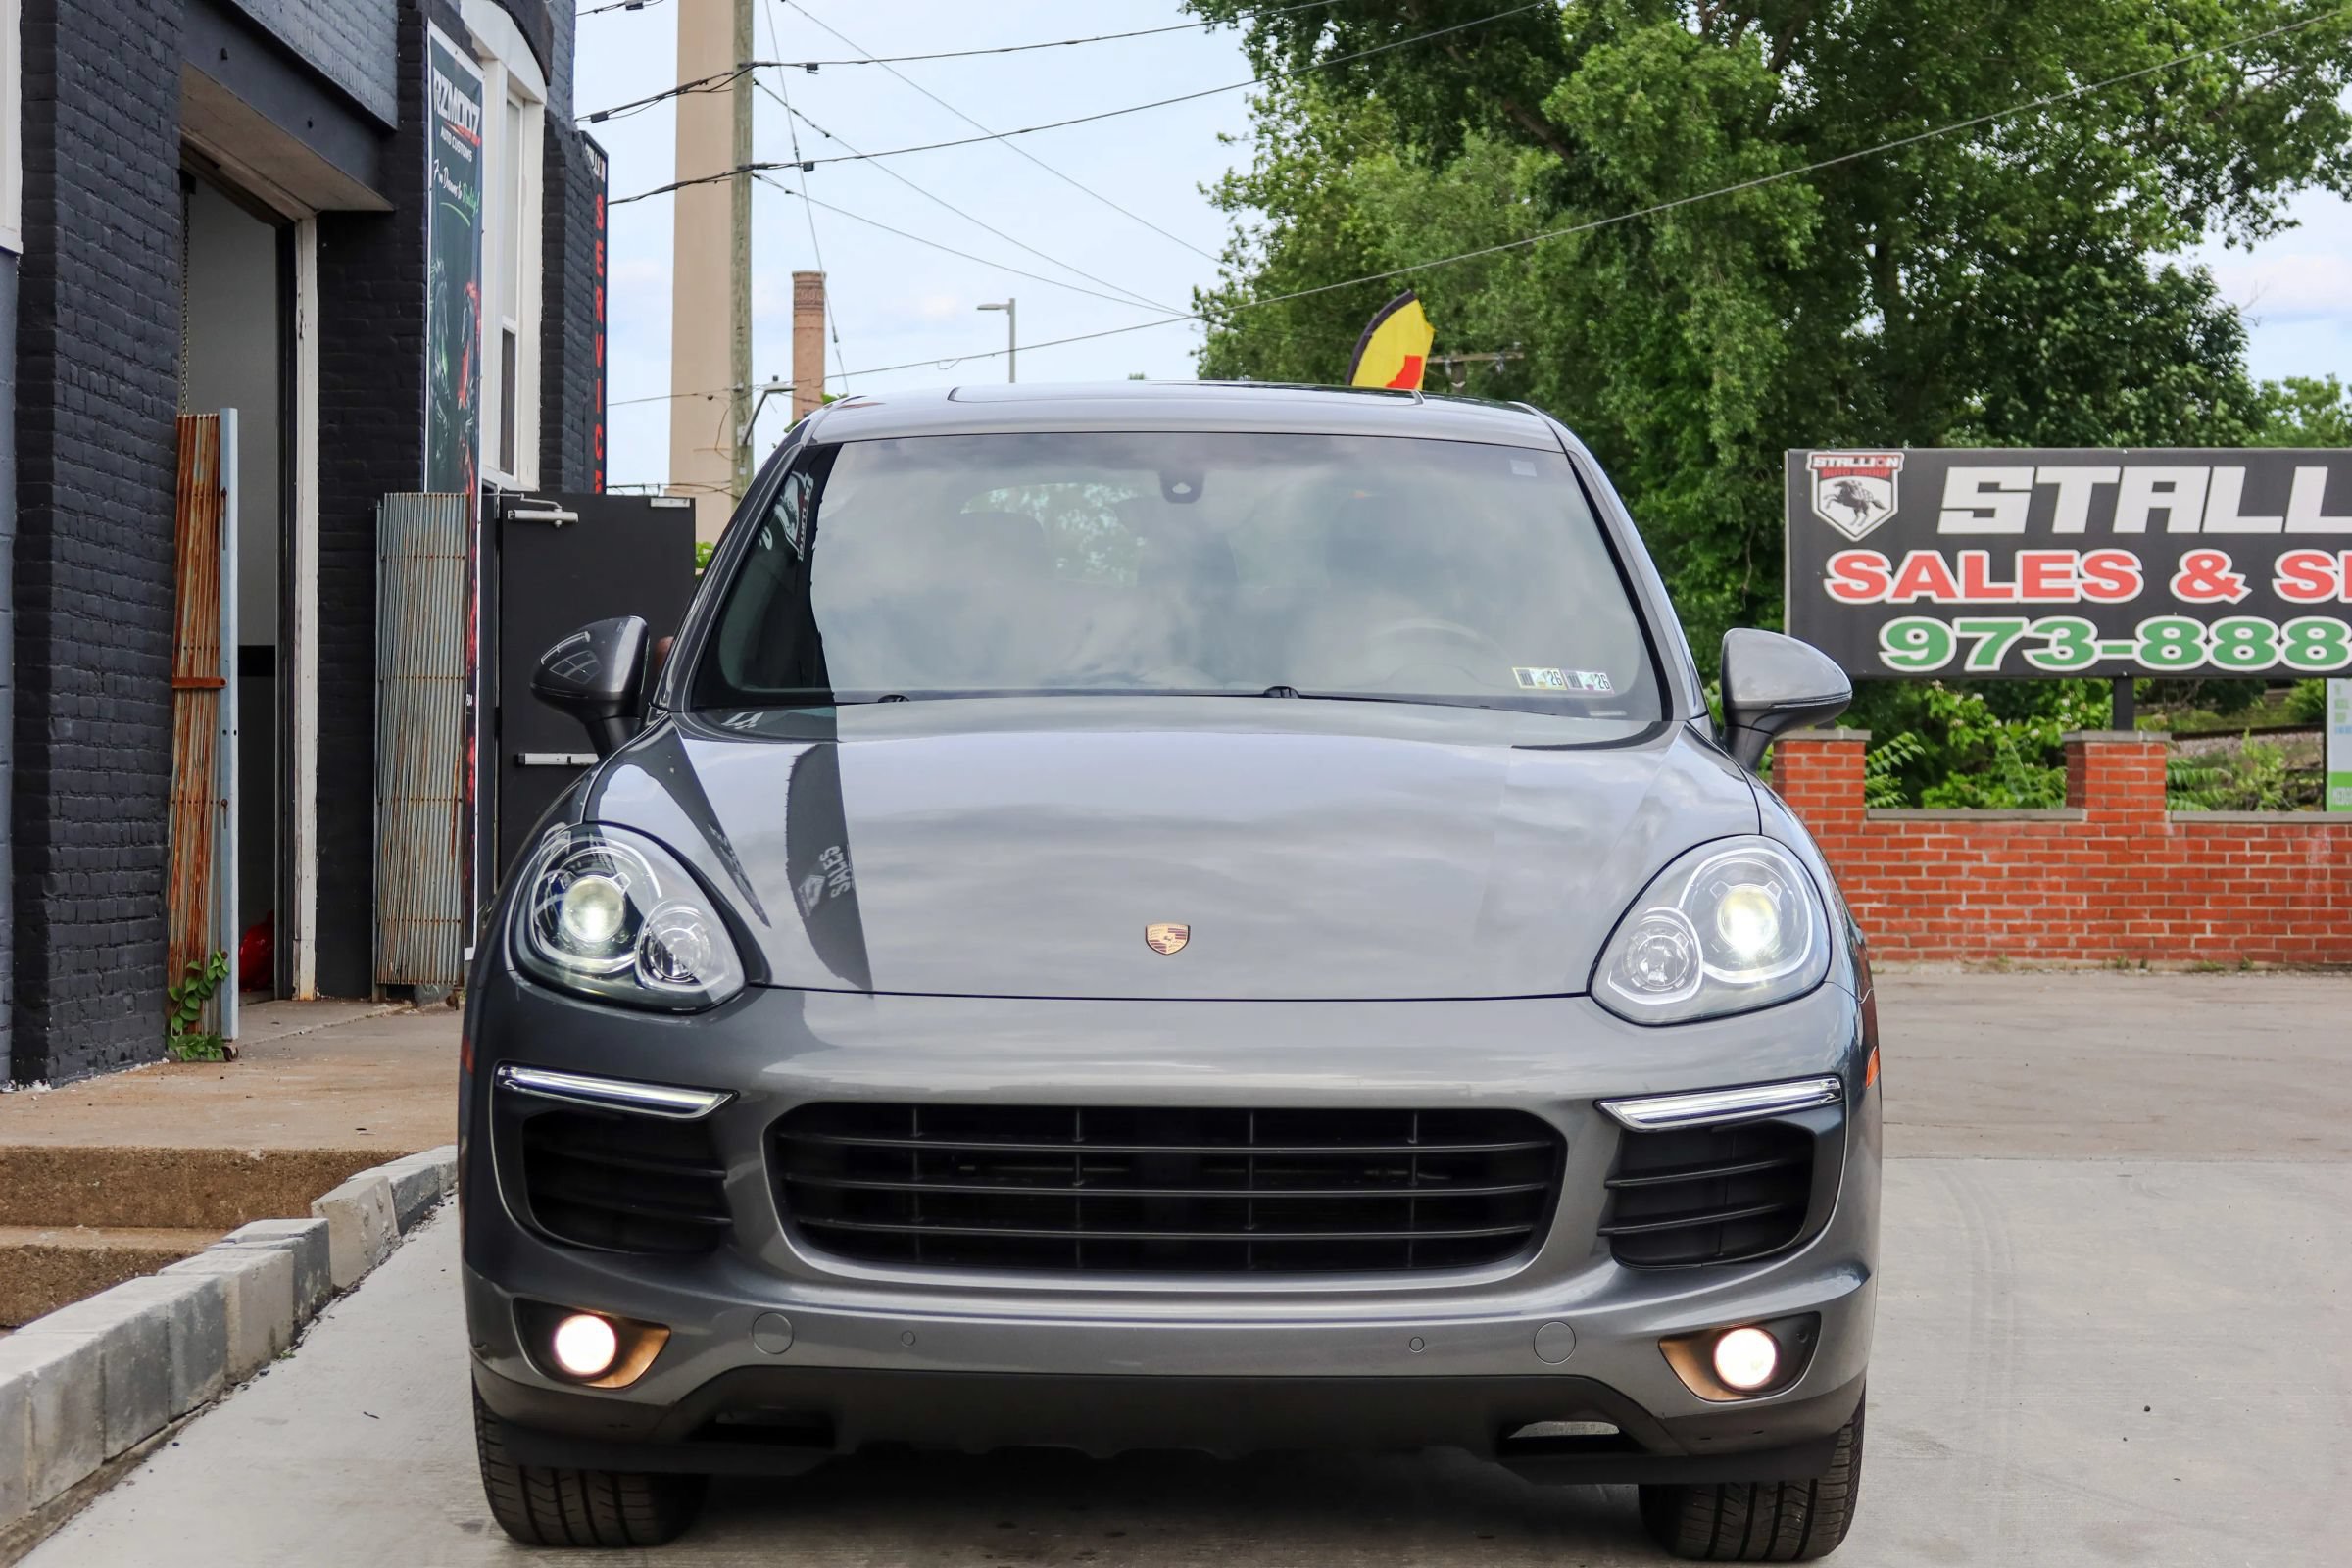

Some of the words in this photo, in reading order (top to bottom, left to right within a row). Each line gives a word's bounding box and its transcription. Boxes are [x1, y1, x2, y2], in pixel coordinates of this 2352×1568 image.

[1811, 456, 1899, 467] STALLION
[1937, 466, 2352, 534] STALL
[1825, 549, 2144, 605] SALES
[2170, 548, 2252, 605] &
[2272, 549, 2352, 604] S
[1548, 670, 1563, 686] 26
[1594, 673, 1611, 690] 26
